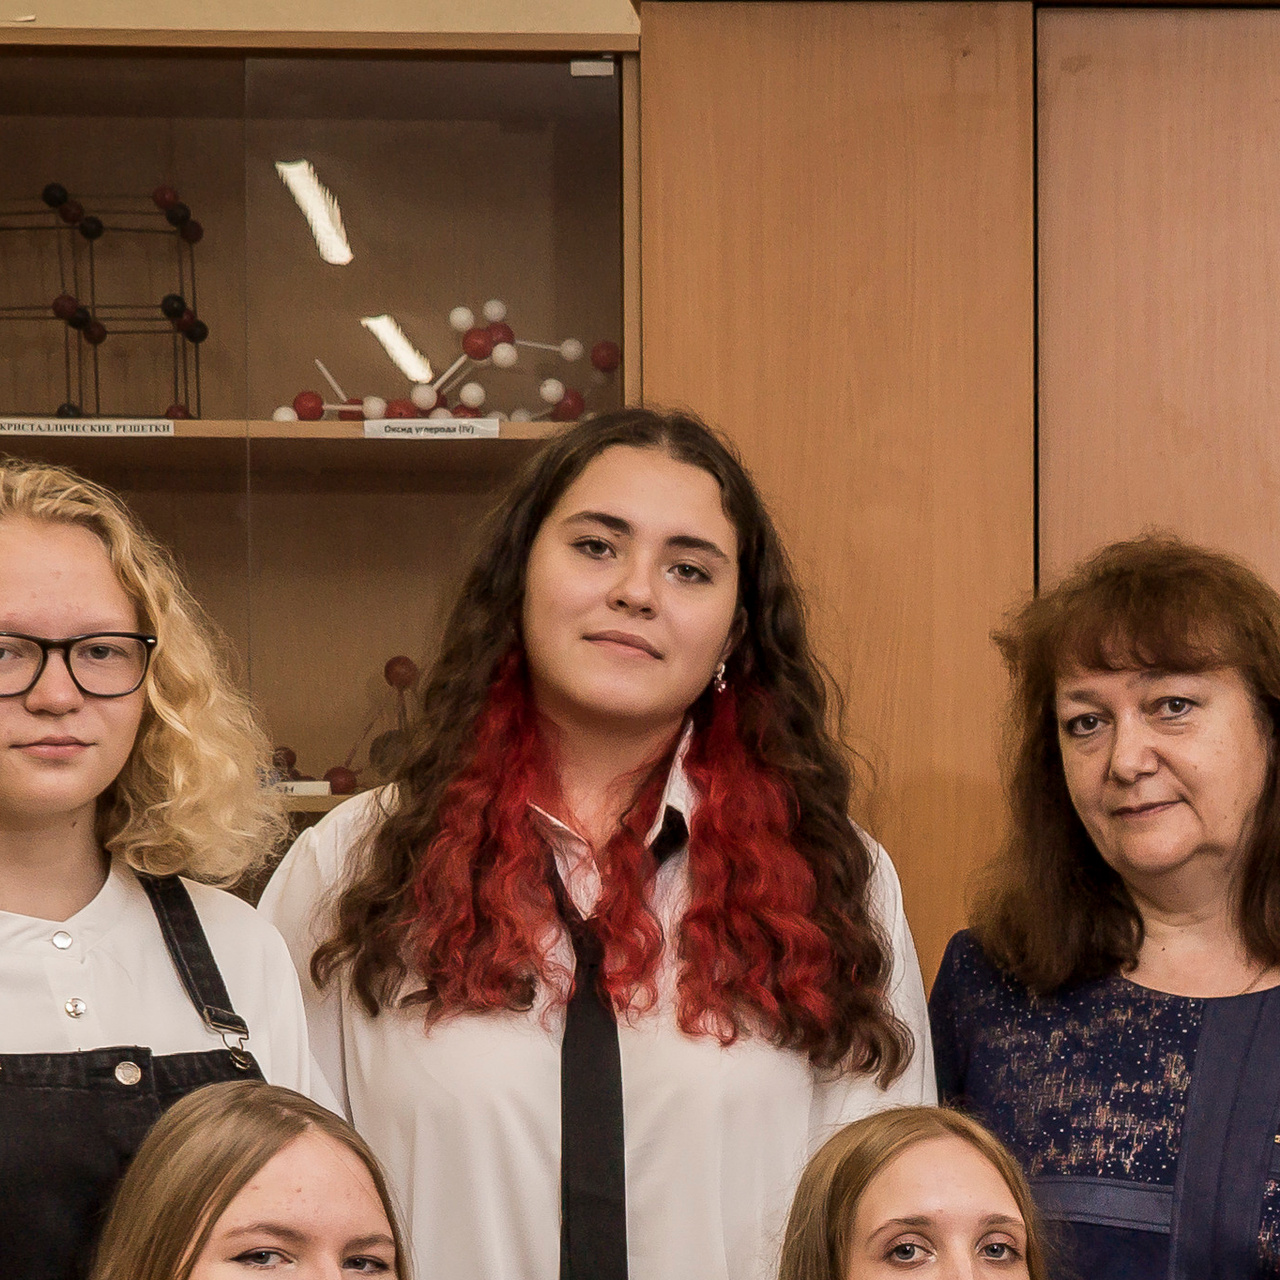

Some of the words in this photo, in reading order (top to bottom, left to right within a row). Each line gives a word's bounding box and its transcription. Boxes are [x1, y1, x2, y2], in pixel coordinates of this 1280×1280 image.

[0, 423, 111, 433] КРИСТАЛЛИЧЕСКИЕ
[116, 424, 170, 433] РЕШЕТКИ
[384, 425, 413, 434] Оксид
